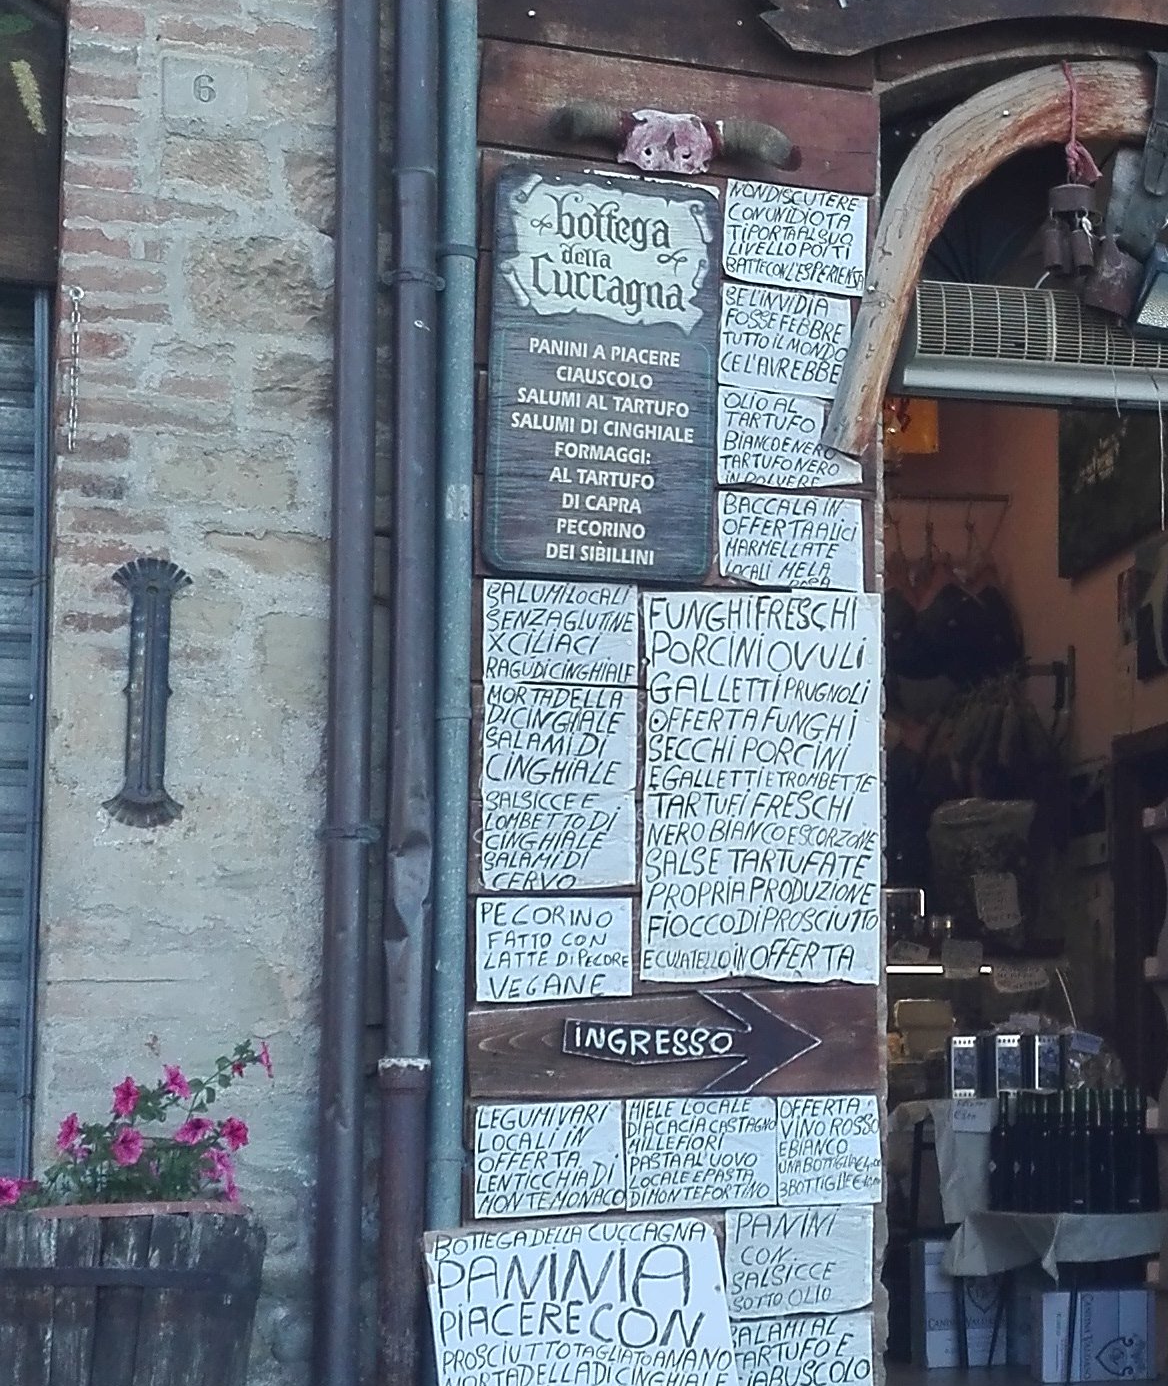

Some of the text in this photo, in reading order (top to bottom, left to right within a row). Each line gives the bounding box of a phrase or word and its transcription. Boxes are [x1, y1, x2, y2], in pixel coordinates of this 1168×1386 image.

[192, 74, 216, 103] 6
[547, 192, 671, 251] bottega
[560, 243, 612, 269] della
[728, 241, 850, 259] LIVELLO POI TI
[531, 254, 687, 316] Cuccagna
[726, 308, 845, 344] FOSSE FEBBRE
[529, 337, 680, 367] PANINI A PIACERE
[723, 331, 769, 349] TUTTO
[786, 338, 849, 362] MONDO
[556, 366, 653, 390] CIAUSCOLO
[517, 387, 689, 419] SALUMI AL TARTUFO
[724, 392, 797, 413] OLIO AL
[511, 413, 694, 444] SALUMI DI CINGHIALE
[725, 411, 815, 433] TARTUFO
[555, 440, 651, 465] FORMAGGI:
[549, 467, 655, 491] AL TARTUFO
[562, 494, 642, 515] DI CAPRA
[556, 518, 646, 540] PECORINO
[722, 516, 813, 539] OFFERTA
[546, 541, 655, 566] DEI SIBILLINI
[726, 537, 839, 559] MARMELLATE
[649, 595, 858, 632] FUNGHI FRESCHI
[651, 630, 867, 672] PORCINI OVULI
[487, 685, 623, 709] MORTADELLA
[650, 671, 871, 705] GALLETTI PRUGNOLI
[650, 706, 859, 742] OFFERTA FUNGHI
[649, 734, 851, 772] SECCHI PORCINI
[486, 751, 621, 785] CINGHIALE
[486, 790, 578, 811] SALSICCE
[650, 789, 856, 822] TARTUFI FRESCHI
[485, 806, 621, 831] LOMBETTO DI
[486, 830, 607, 851] CINGHIALE
[645, 846, 872, 883] SALSE TARTUFATE
[647, 876, 877, 910] PROPRIA PRODUZIONE
[481, 902, 613, 928] PECORINO
[488, 930, 607, 949] FATTO CON
[484, 951, 548, 970] LATTE
[489, 973, 606, 1000] VEGANE
[574, 1022, 734, 1056] INGRESSO
[478, 1102, 612, 1130] LEGUMI VARI
[629, 1098, 751, 1121] MIELE LOCALE
[780, 1097, 860, 1118] OFFERTA
[781, 1117, 825, 1139] VINO
[735, 1207, 840, 1245] PANINI
[435, 1222, 707, 1261] BOTTEGA DELLA CUCCAGNA
[437, 1243, 691, 1309] PANINI A
[731, 1262, 836, 1295] SALSICCE
[733, 1284, 832, 1313] SOTTO OLIO
[440, 1300, 706, 1349] PIACERE CON
